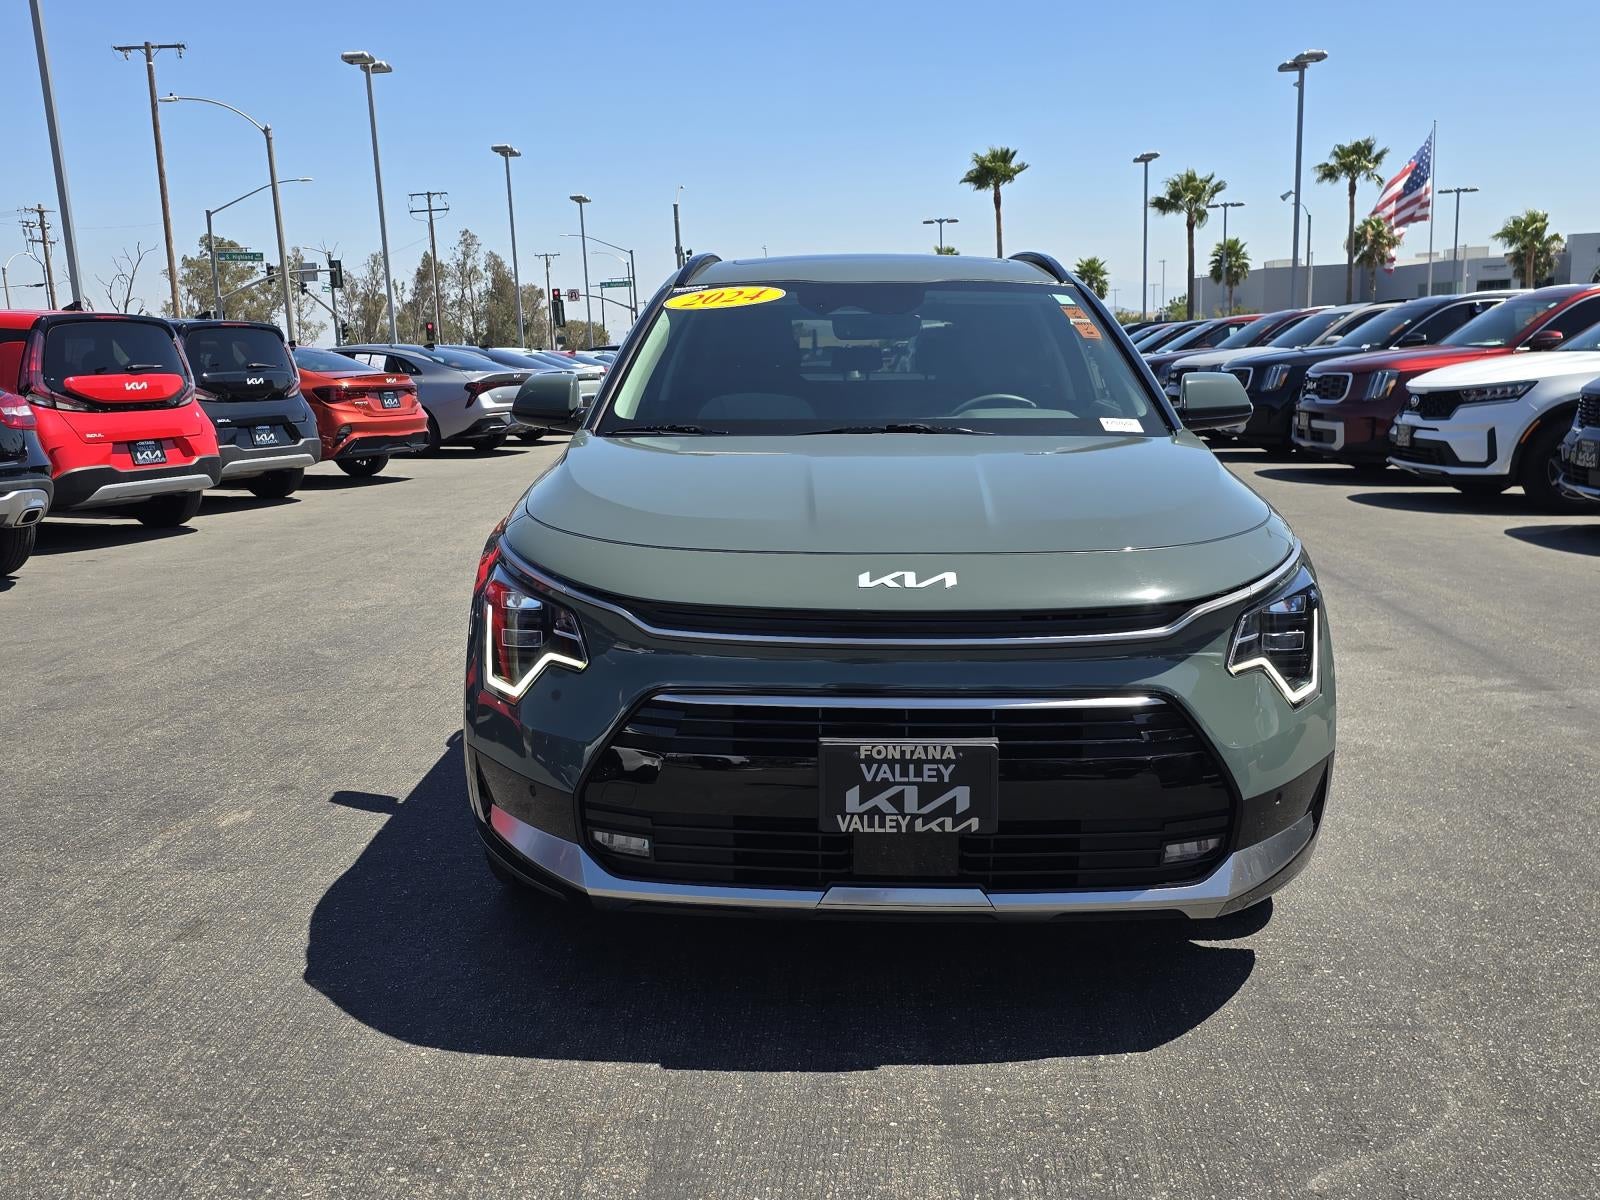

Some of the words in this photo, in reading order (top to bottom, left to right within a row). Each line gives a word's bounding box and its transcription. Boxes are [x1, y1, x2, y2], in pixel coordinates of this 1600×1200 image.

[681, 288, 770, 307] 2024
[858, 571, 957, 589] KIA
[859, 745, 956, 760] FONTANA
[860, 763, 956, 783] VALLEY
[845, 784, 970, 815] KIA
[836, 814, 911, 833] VALLEY
[914, 817, 979, 833] KIA
